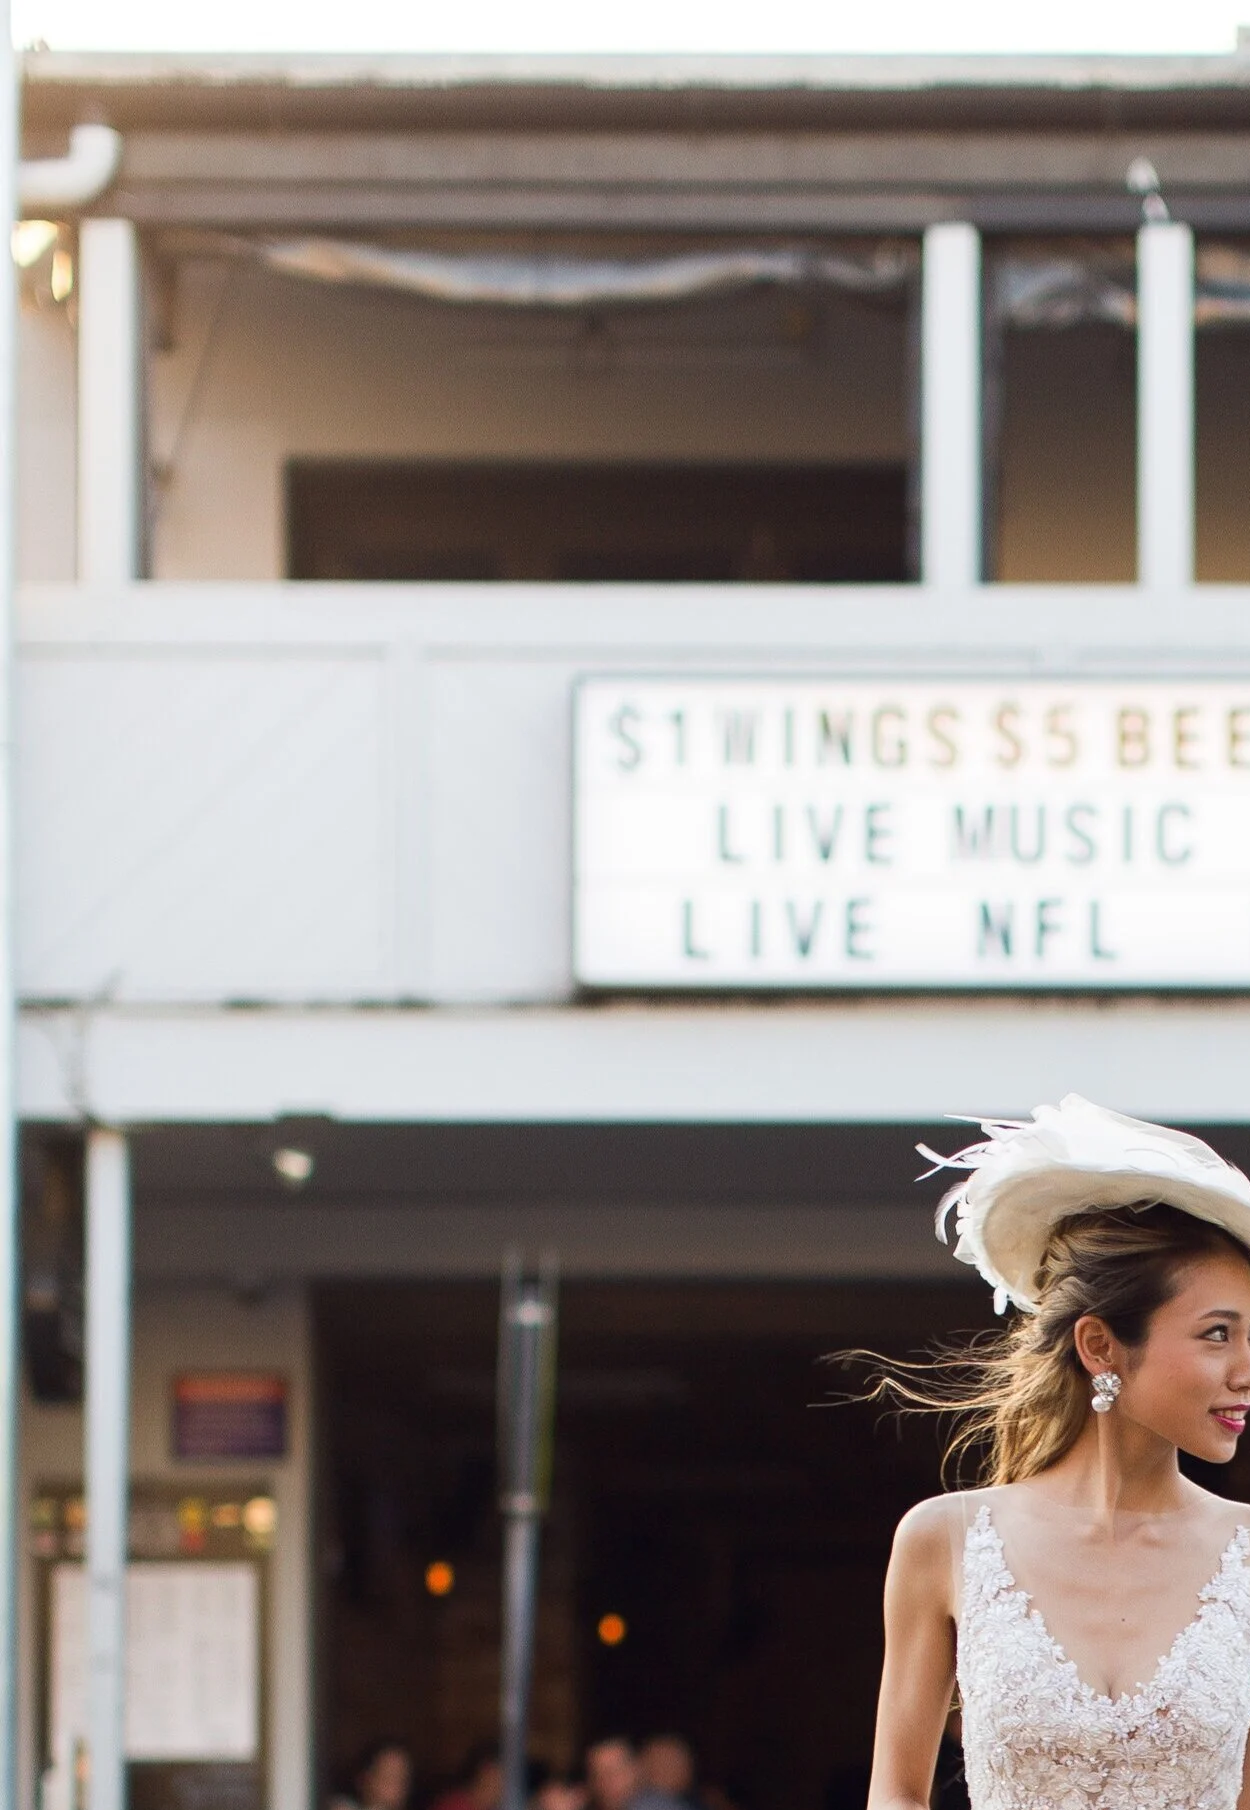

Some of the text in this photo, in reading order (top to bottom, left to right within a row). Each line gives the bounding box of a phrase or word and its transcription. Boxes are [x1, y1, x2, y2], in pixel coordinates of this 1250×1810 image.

[612, 702, 686, 772] $1
[718, 704, 961, 770] WINGS
[990, 701, 1079, 770] $5
[717, 802, 893, 864] LIVE
[951, 802, 1193, 865] MUSIC
[683, 898, 877, 961] LIVE
[977, 898, 1120, 961] NFL
